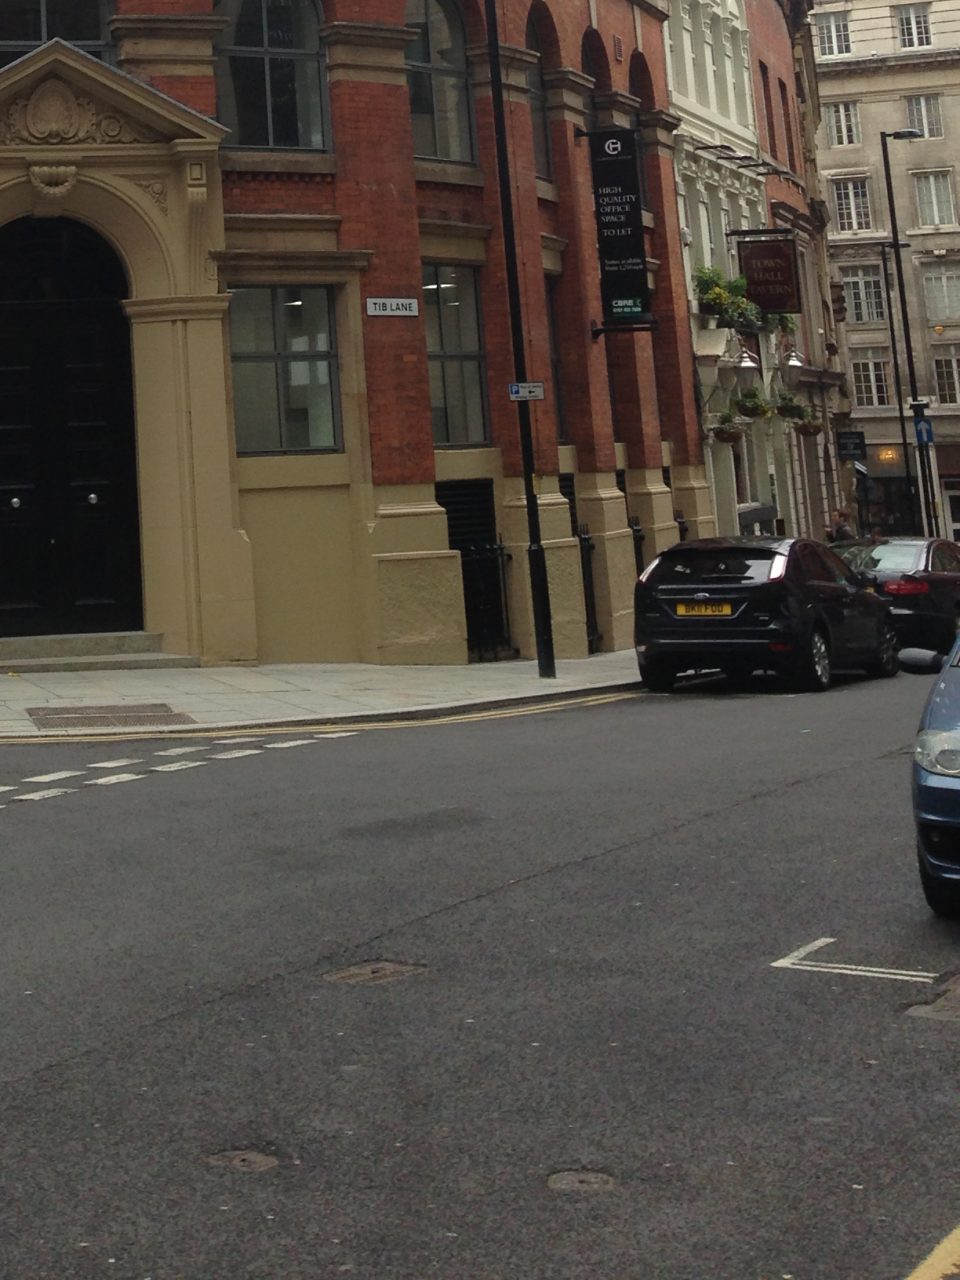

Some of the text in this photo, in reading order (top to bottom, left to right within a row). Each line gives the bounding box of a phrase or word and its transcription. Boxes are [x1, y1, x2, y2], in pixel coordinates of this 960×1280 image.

[598, 186, 622, 194] HIGH
[600, 194, 637, 205] QUALITY
[600, 205, 631, 213] OFFICE
[601, 214, 625, 222] SPACE
[617, 228, 632, 236] LET
[752, 258, 785, 269] TOWN
[753, 271, 785, 281] HALL
[372, 302, 413, 312] TIB LANE
